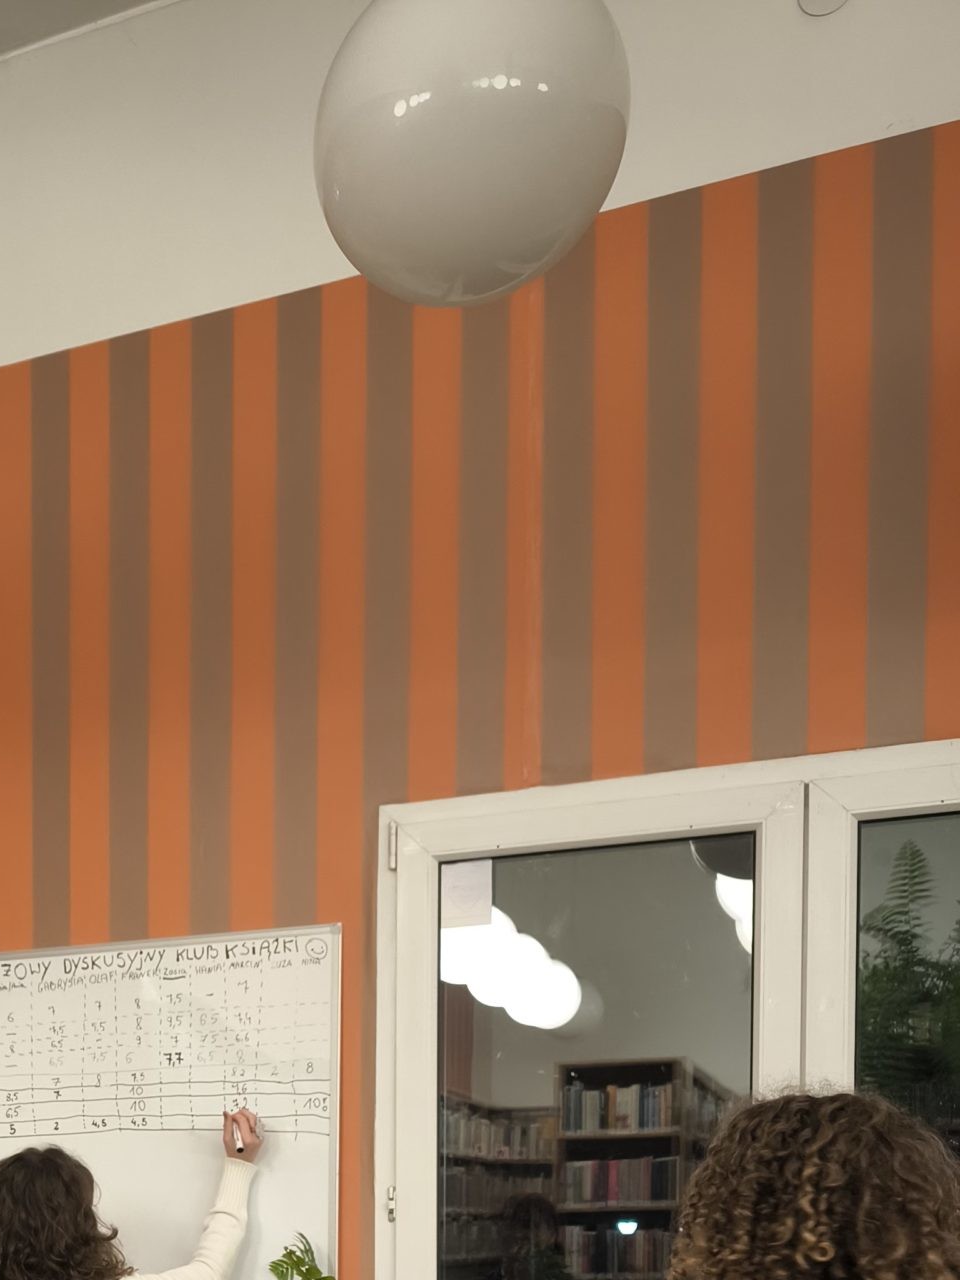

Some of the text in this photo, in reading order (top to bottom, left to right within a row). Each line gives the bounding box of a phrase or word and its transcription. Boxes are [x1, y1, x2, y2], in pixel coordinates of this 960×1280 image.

[176, 944, 219, 963] KLUB
[237, 979, 249, 994] 7
[7, 1012, 15, 1023] 6
[136, 1016, 142, 1031] 8
[163, 1052, 184, 1067] 7,7
[306, 1061, 314, 1074] 8
[129, 1086, 144, 1096] 10
[5, 1105, 22, 1119] 6,5
[129, 1099, 146, 1112] 10
[9, 1123, 16, 1135] 5
[53, 1121, 60, 1131] 2
[91, 1118, 107, 1128] 4,5
